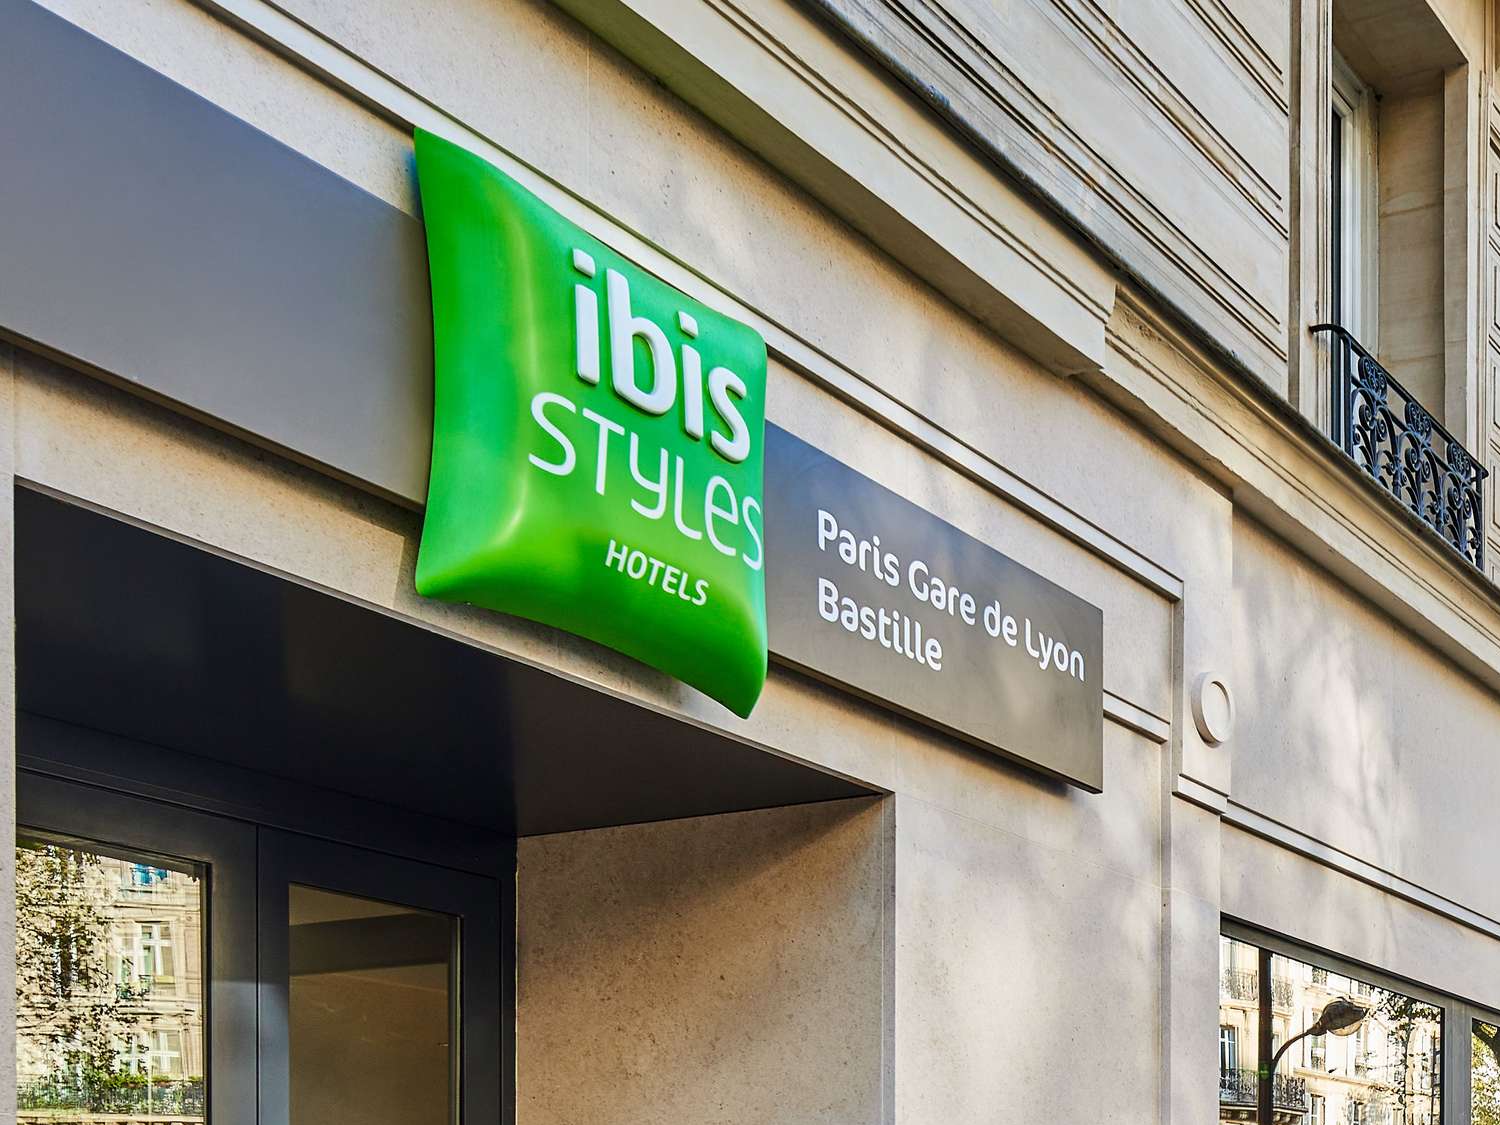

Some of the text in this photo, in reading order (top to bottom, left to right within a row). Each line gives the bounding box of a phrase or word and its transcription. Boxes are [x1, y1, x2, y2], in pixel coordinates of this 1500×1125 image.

[572, 247, 751, 463] ibis
[605, 539, 709, 606] HOTELS
[817, 509, 1085, 681] Paris Gare de Lyon
[817, 577, 943, 671] Bastille
